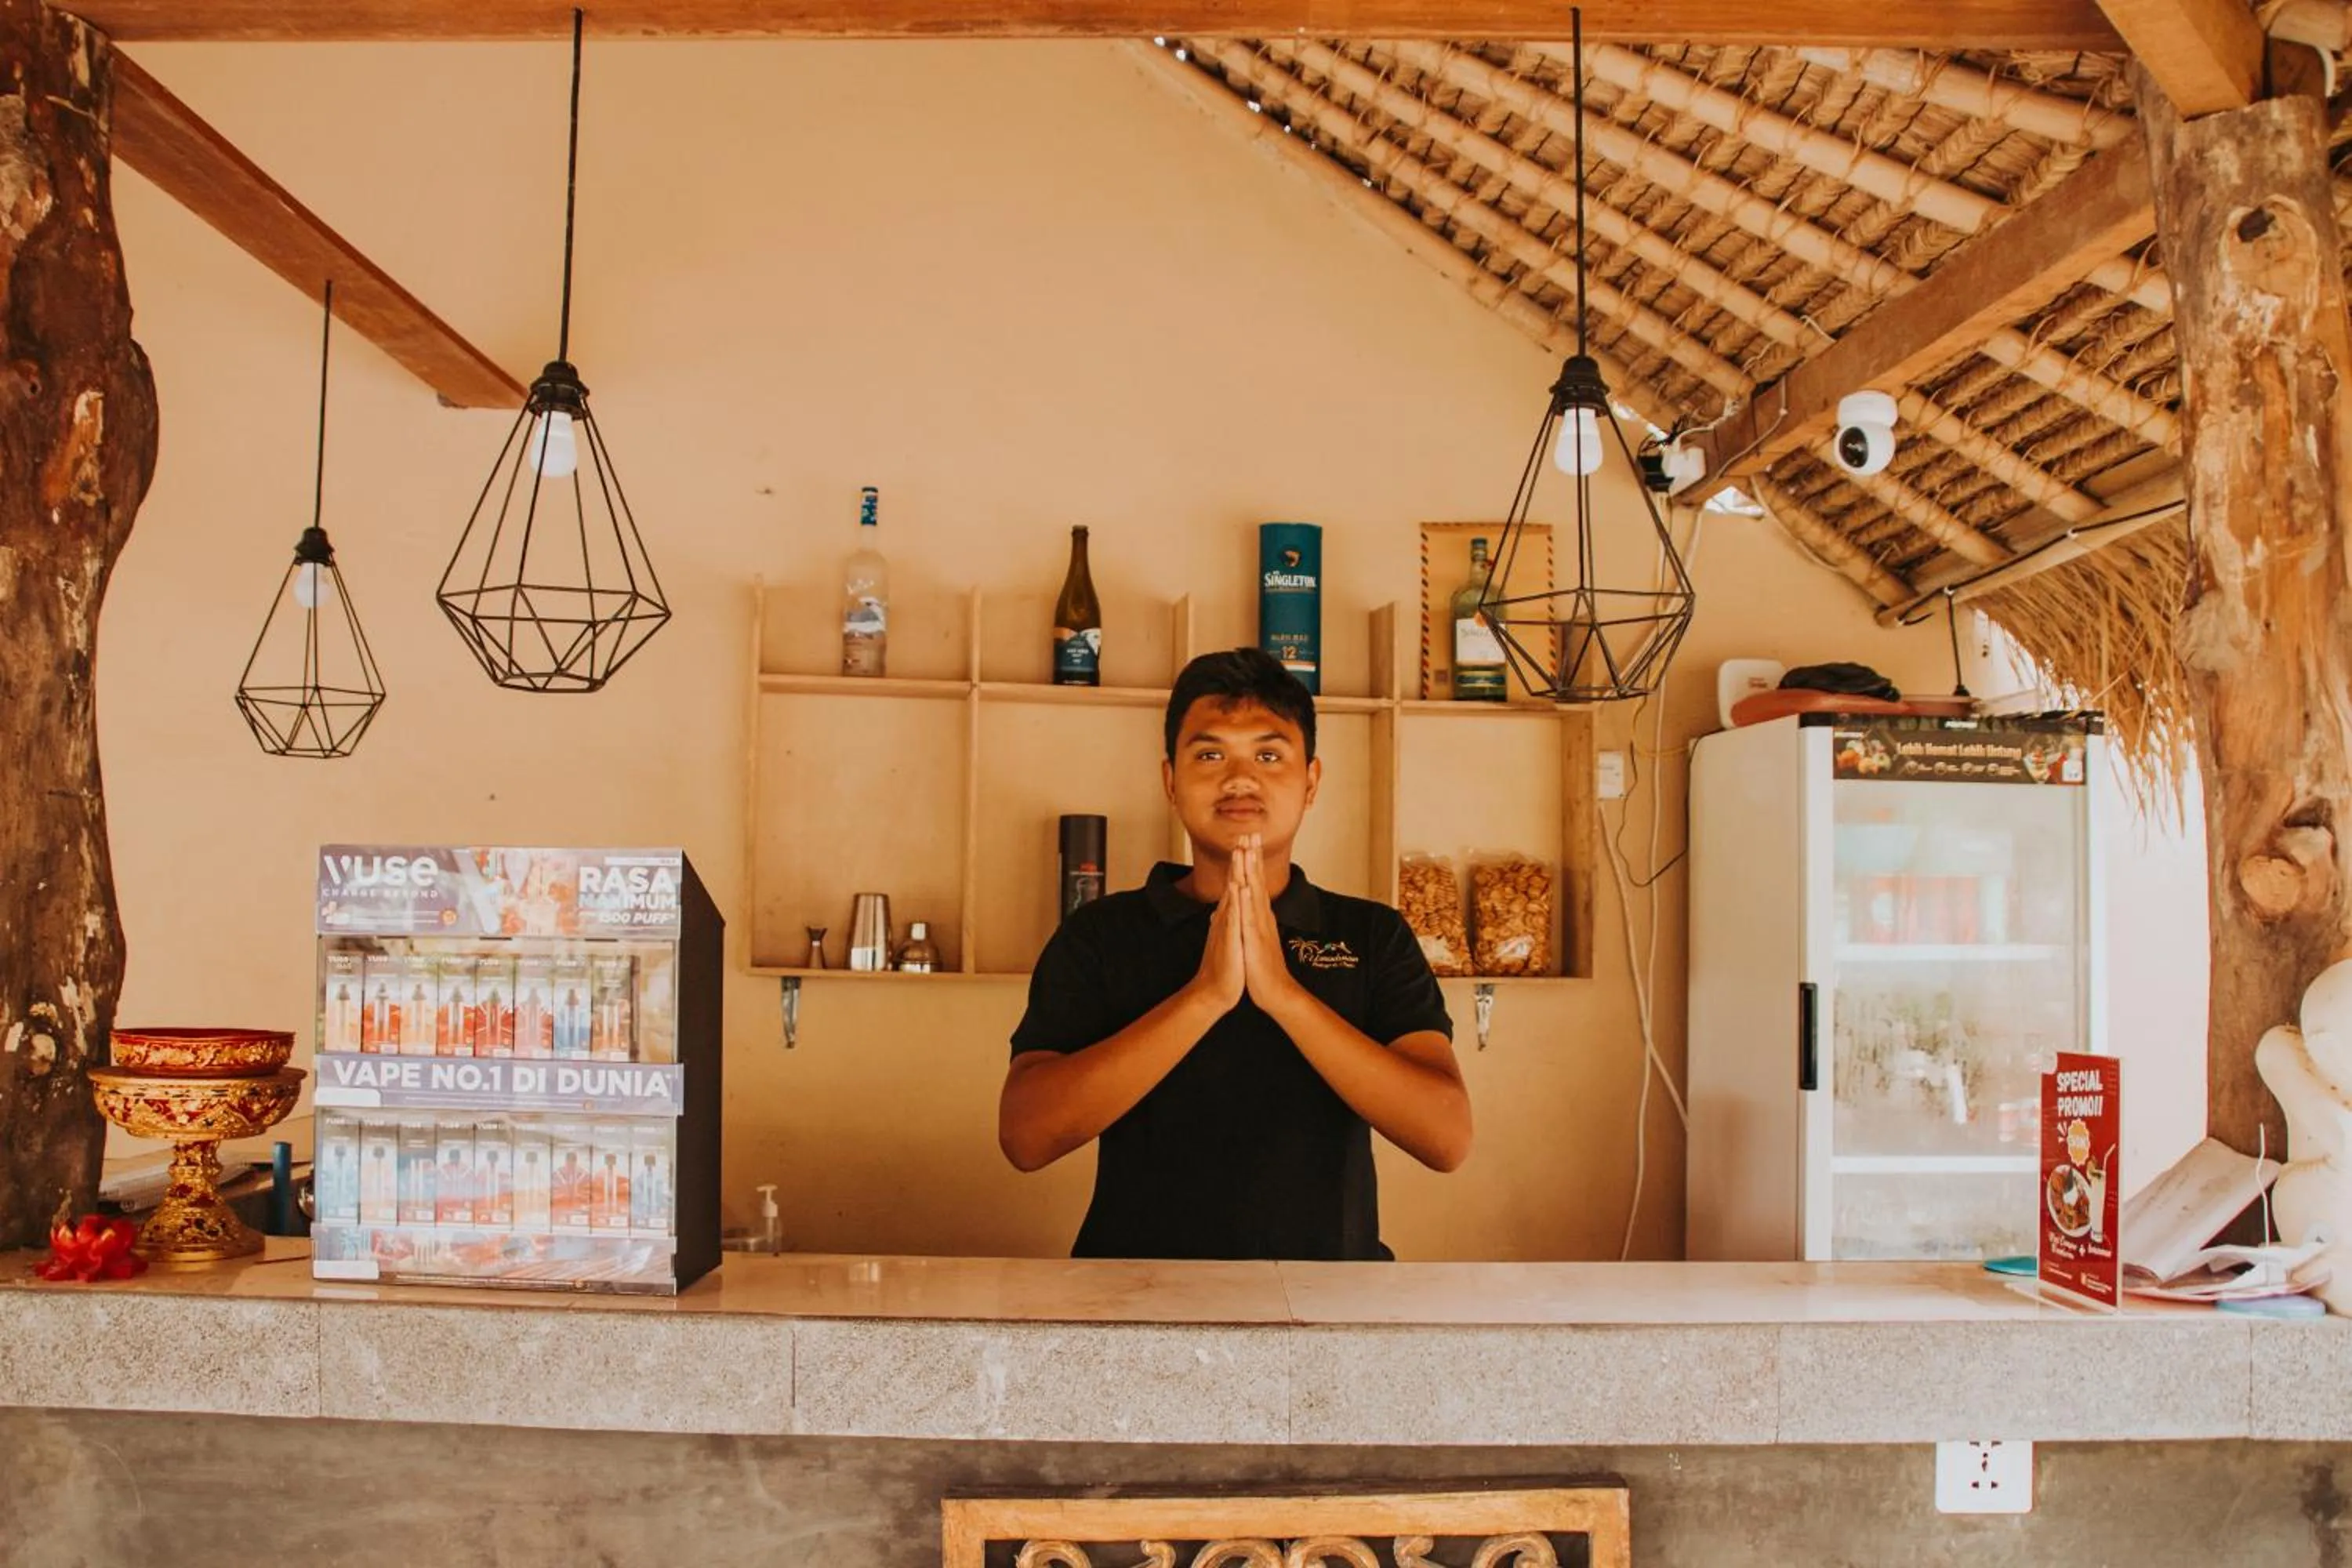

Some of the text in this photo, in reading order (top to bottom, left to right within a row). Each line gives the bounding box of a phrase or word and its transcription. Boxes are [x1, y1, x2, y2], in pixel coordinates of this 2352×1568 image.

[579, 866, 676, 893] RASA
[333, 1060, 422, 1088] VAPE
[431, 1064, 502, 1091] NO.1
[512, 1066, 549, 1094] DI
[2056, 1069, 2103, 1092] SPECIAL
